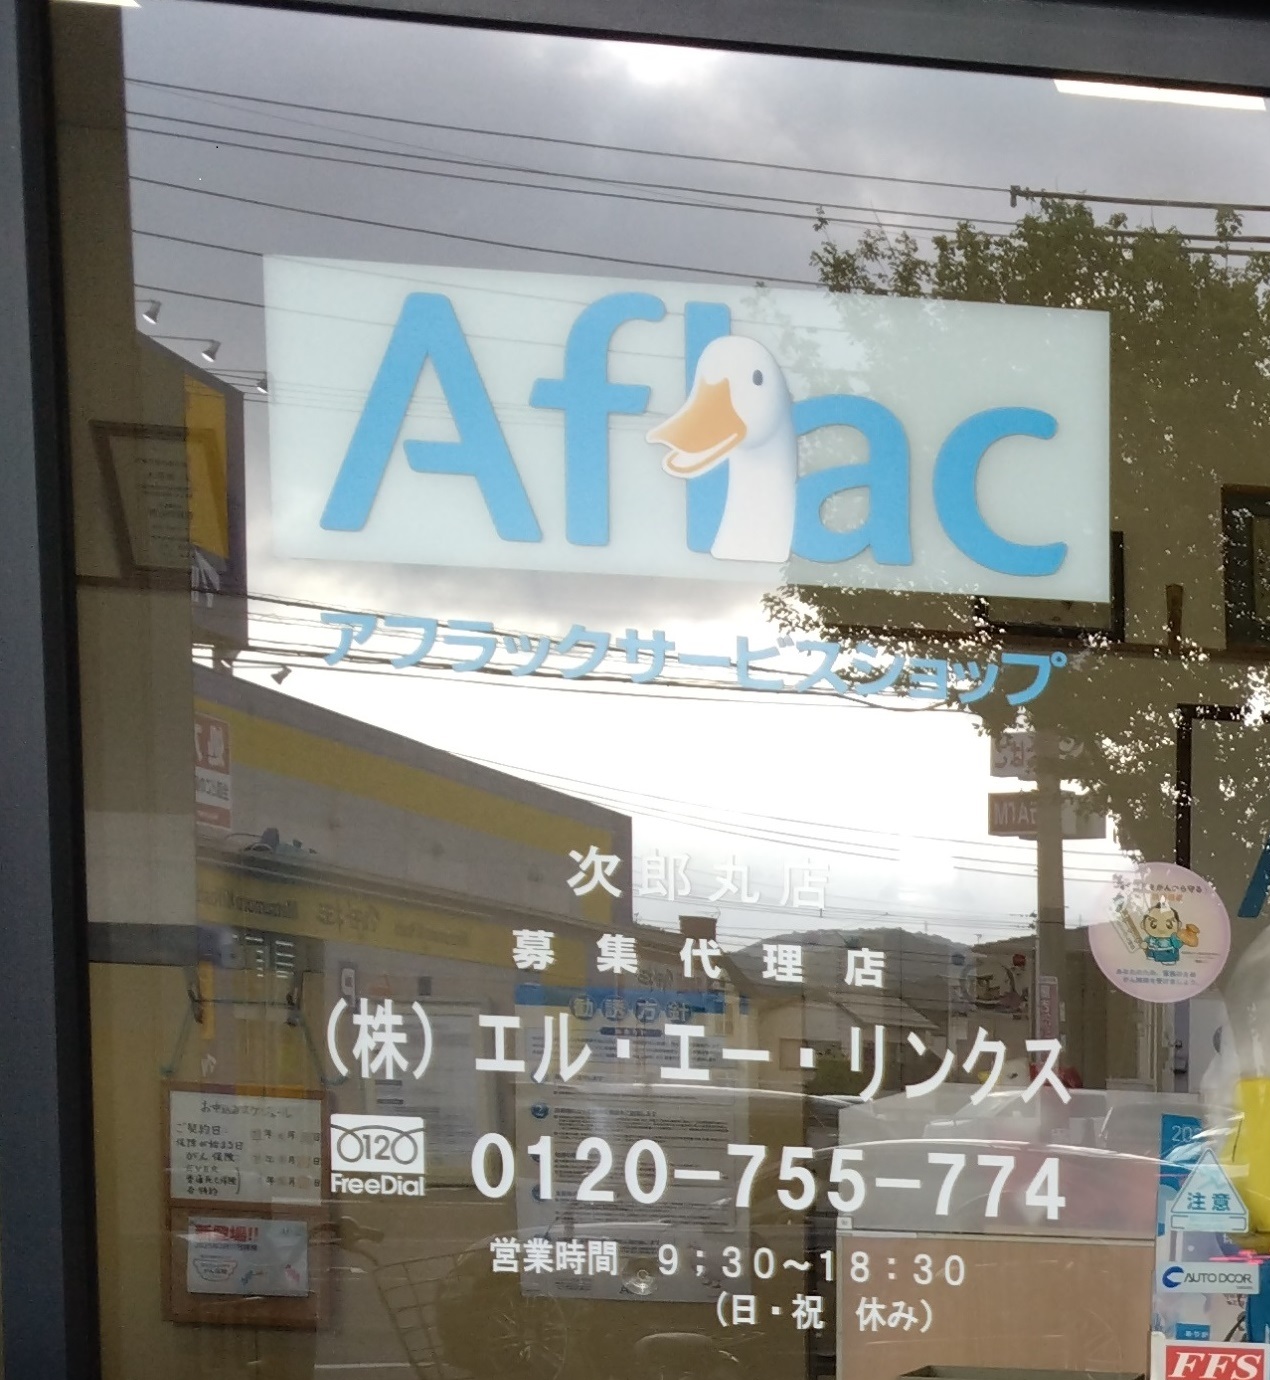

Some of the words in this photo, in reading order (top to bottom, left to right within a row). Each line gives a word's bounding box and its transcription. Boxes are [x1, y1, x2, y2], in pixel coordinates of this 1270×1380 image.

[320, 291, 1067, 576] Aflac
[320, 613, 1067, 706] アフラックサービスショップ
[566, 845, 830, 910] 次郎丸店
[512, 928, 887, 988] 募集代理店
[326, 997, 434, 1081] (株)
[475, 1012, 1074, 1106] エル・エー・リンクス
[330, 1173, 426, 1196] FreeDial
[470, 1131, 1066, 1221] 0120-755-774
[1187, 1191, 1231, 1211] 注意
[489, 1238, 620, 1278] 営業時間
[1168, 1351, 1264, 1380] FFS
